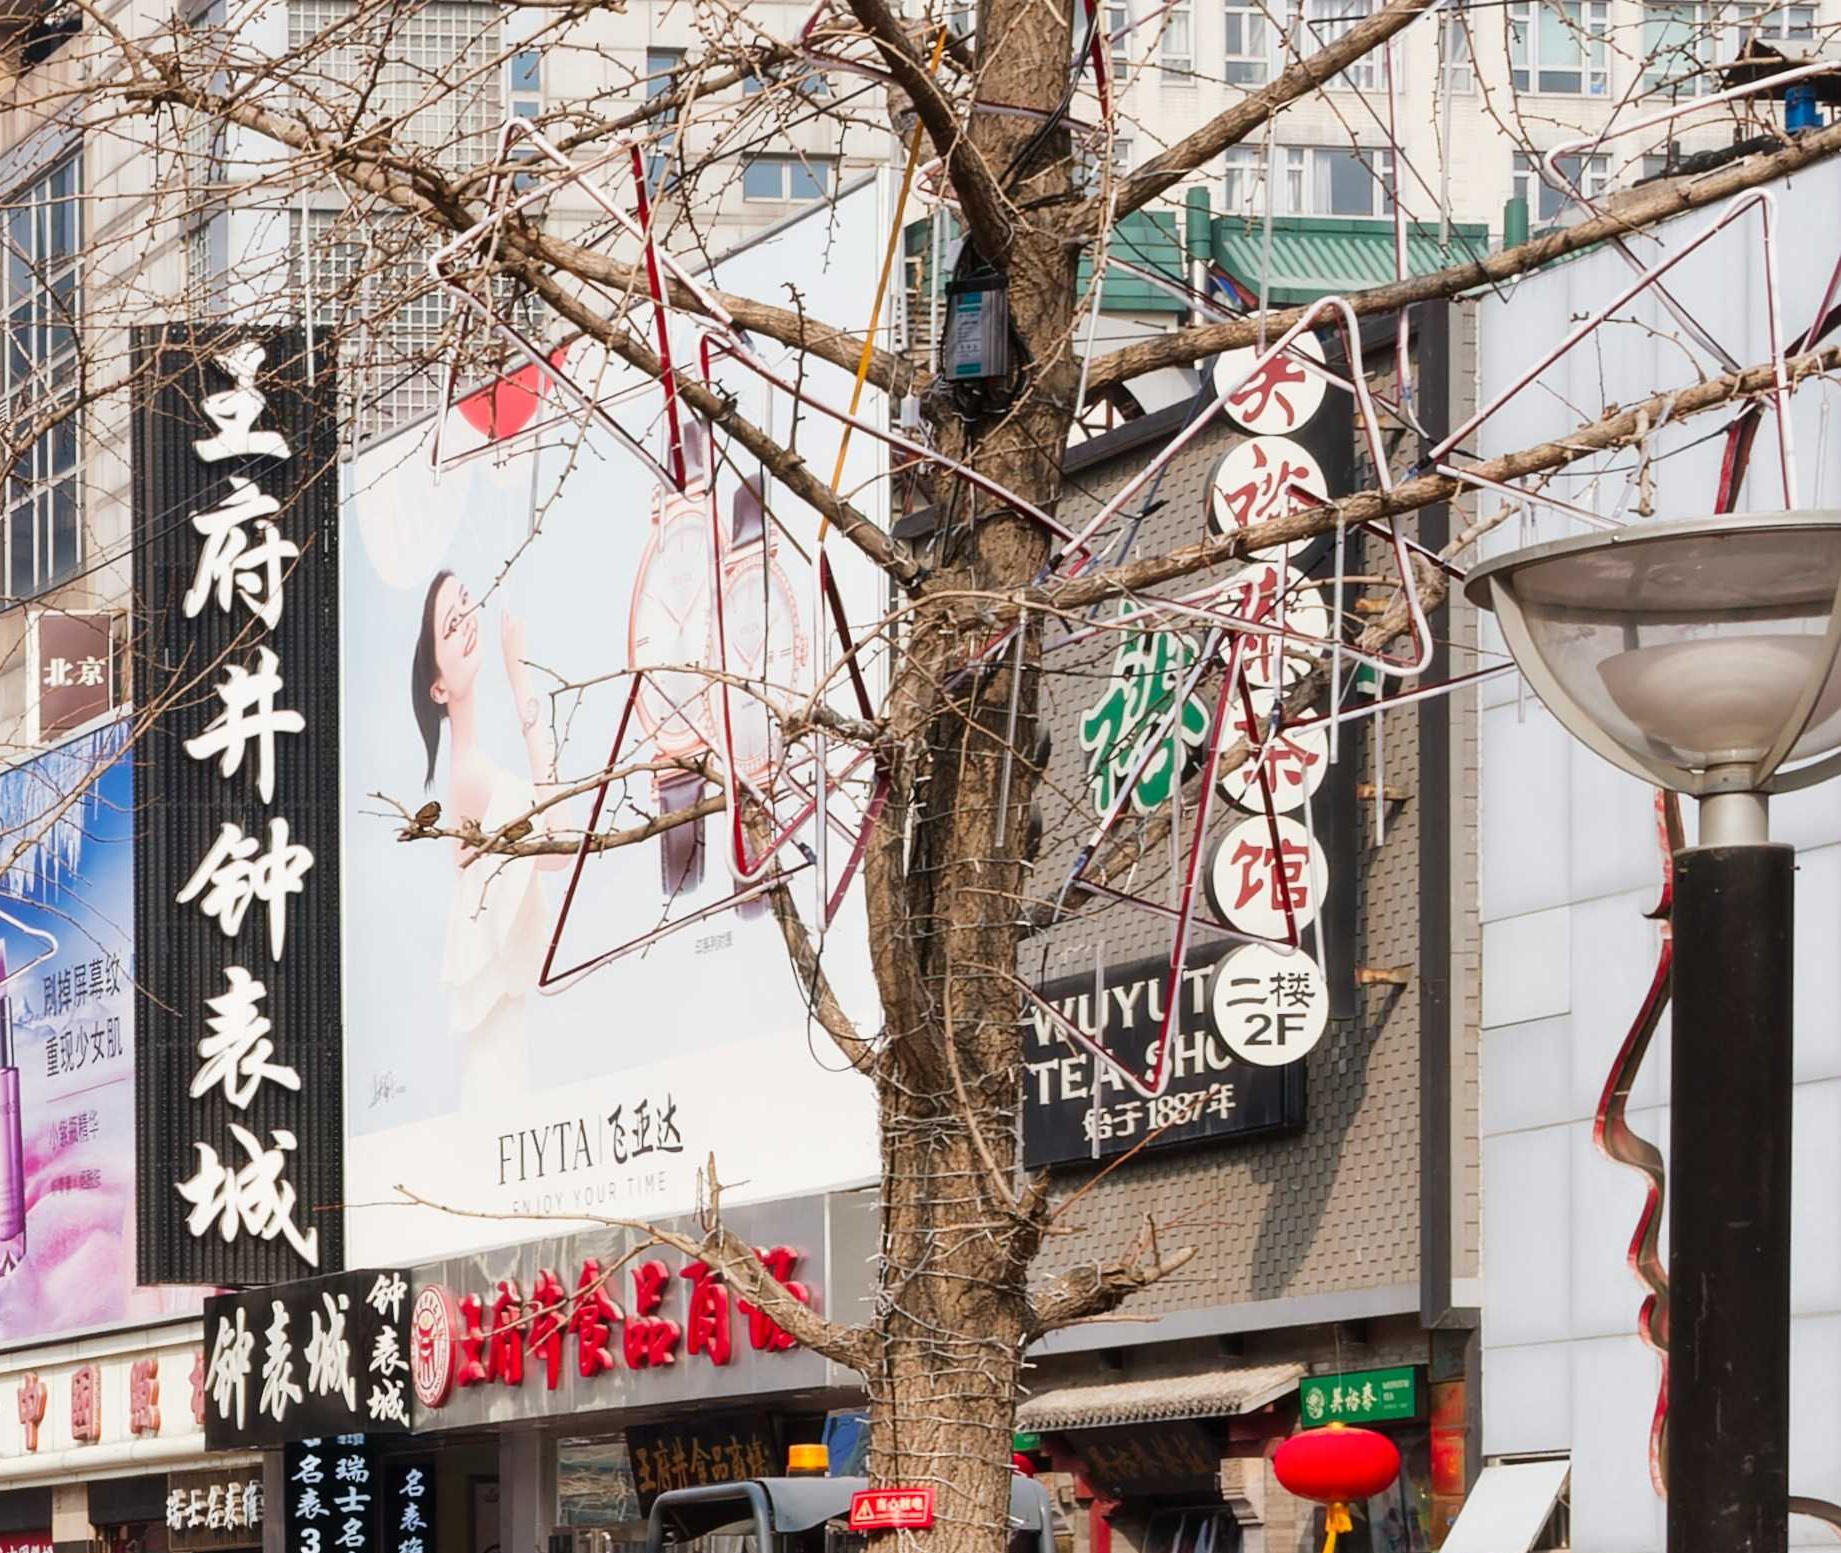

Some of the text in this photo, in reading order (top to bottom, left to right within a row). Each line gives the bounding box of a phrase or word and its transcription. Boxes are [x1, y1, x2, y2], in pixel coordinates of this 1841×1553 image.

[43, 656, 107, 687] 北京
[176, 341, 319, 1269] 王府井钟表城
[1030, 963, 1216, 1047] WUYUT
[1226, 970, 1316, 1009] 二楼
[45, 1016, 123, 1078] 重现少女肌
[1145, 1030, 1232, 1084] SHO
[1243, 1012, 1307, 1047] 2F
[497, 1091, 684, 1186] FIYTA 飞亚达
[573, 1181, 617, 1208] YOUR
[627, 1170, 667, 1197] TIME
[203, 1291, 357, 1431] 钟表城
[365, 1271, 411, 1428] 钟表城
